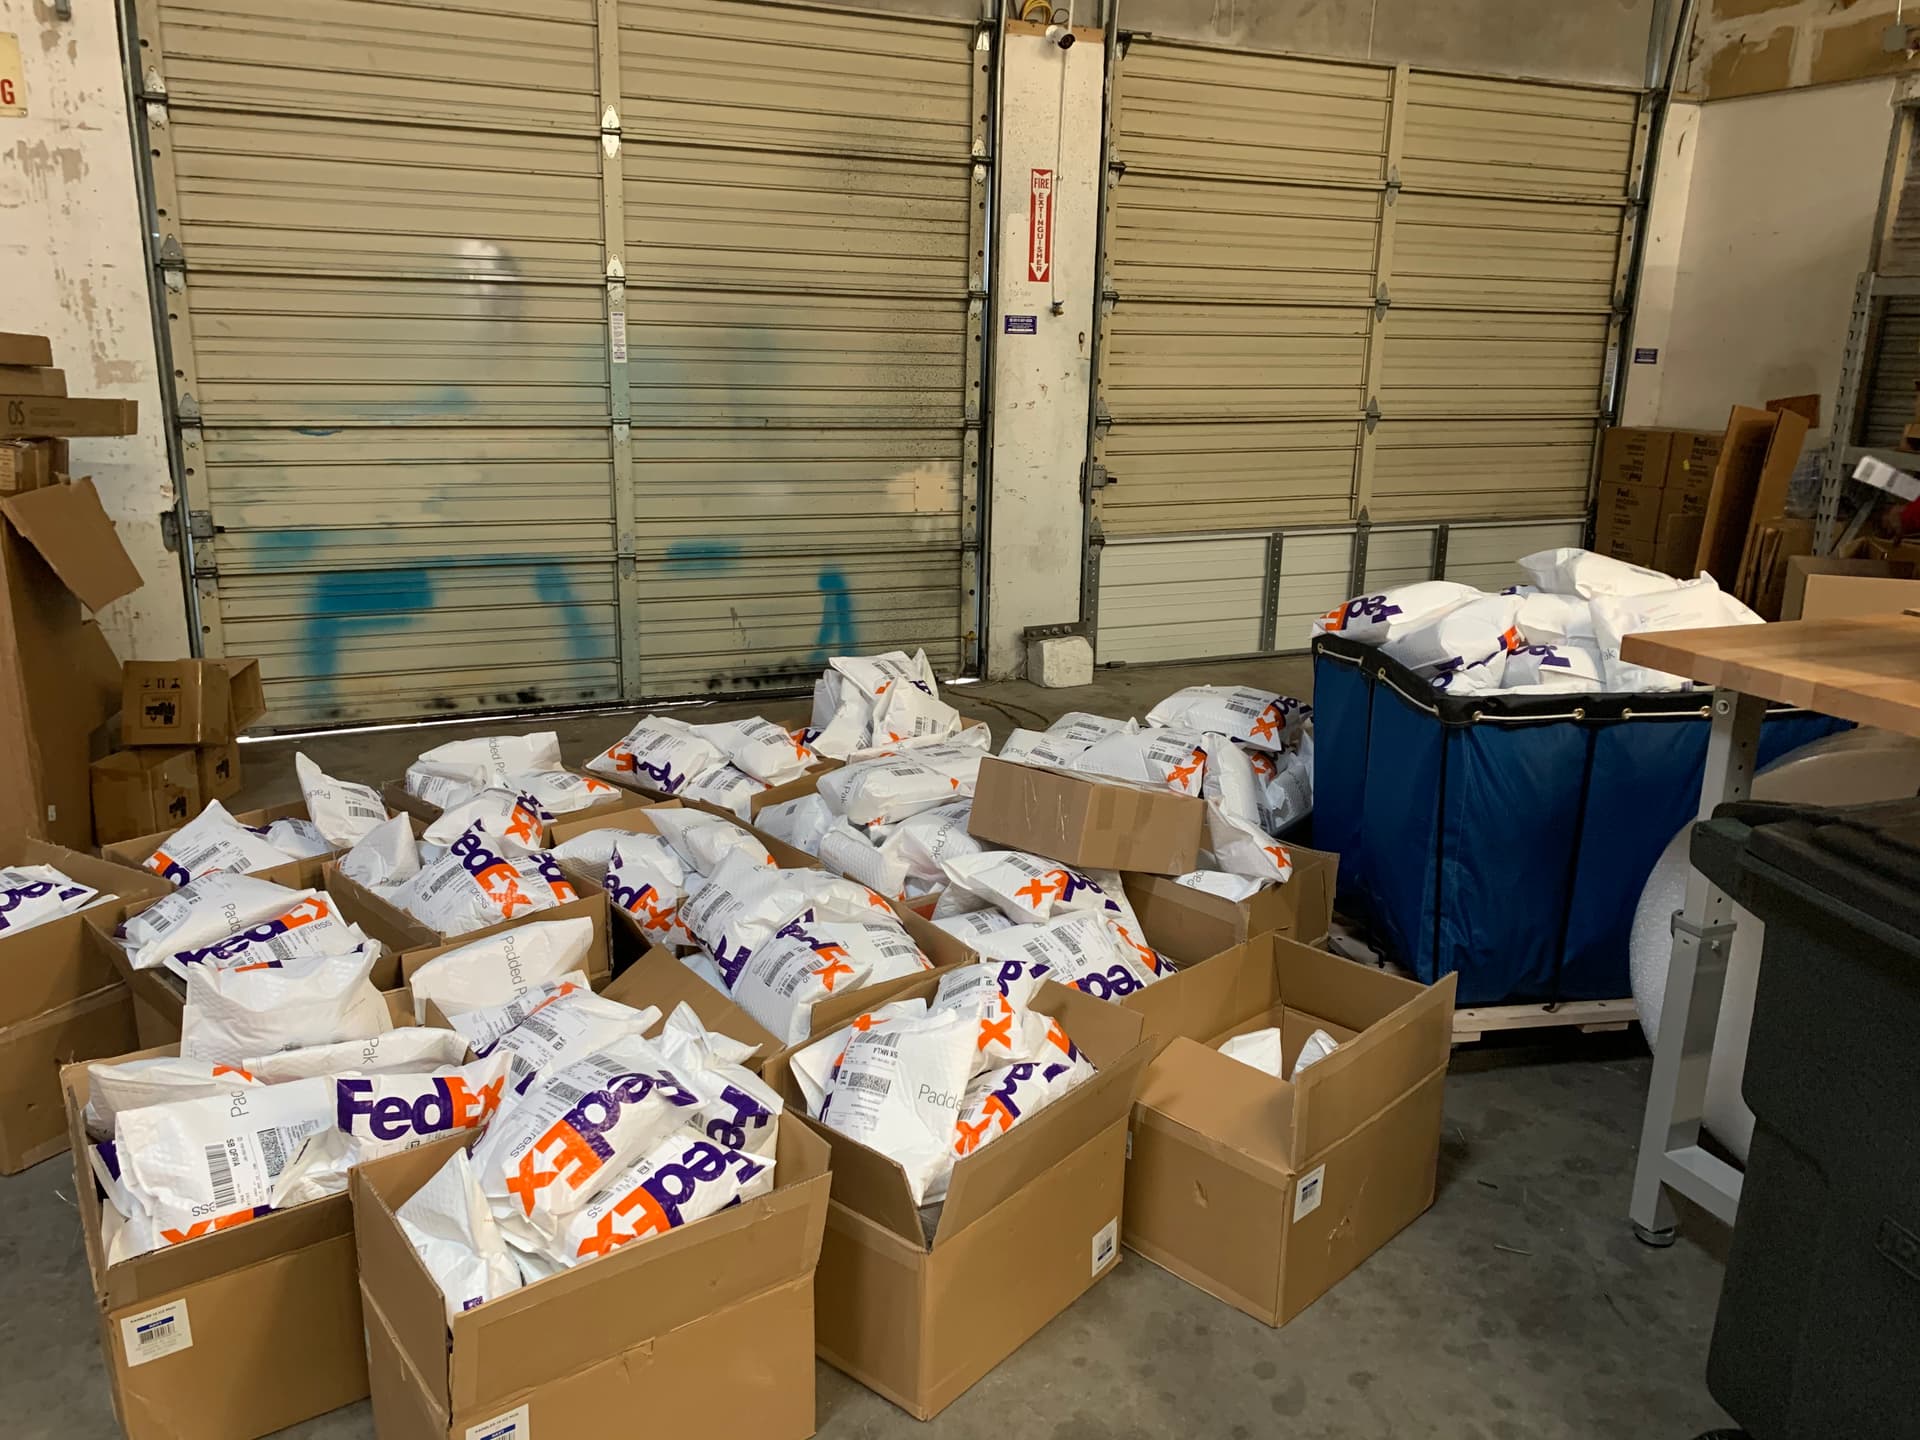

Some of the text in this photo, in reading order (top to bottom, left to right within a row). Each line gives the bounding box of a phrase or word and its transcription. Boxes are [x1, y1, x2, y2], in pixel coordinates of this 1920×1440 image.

[1034, 178, 1050, 190] FIRE
[1036, 192, 1045, 273] EXTINGUISHER
[1320, 595, 1403, 631] FedE
[501, 935, 527, 985] Padded
[363, 1037, 379, 1065] Pak
[337, 1075, 506, 1141] FedEx
